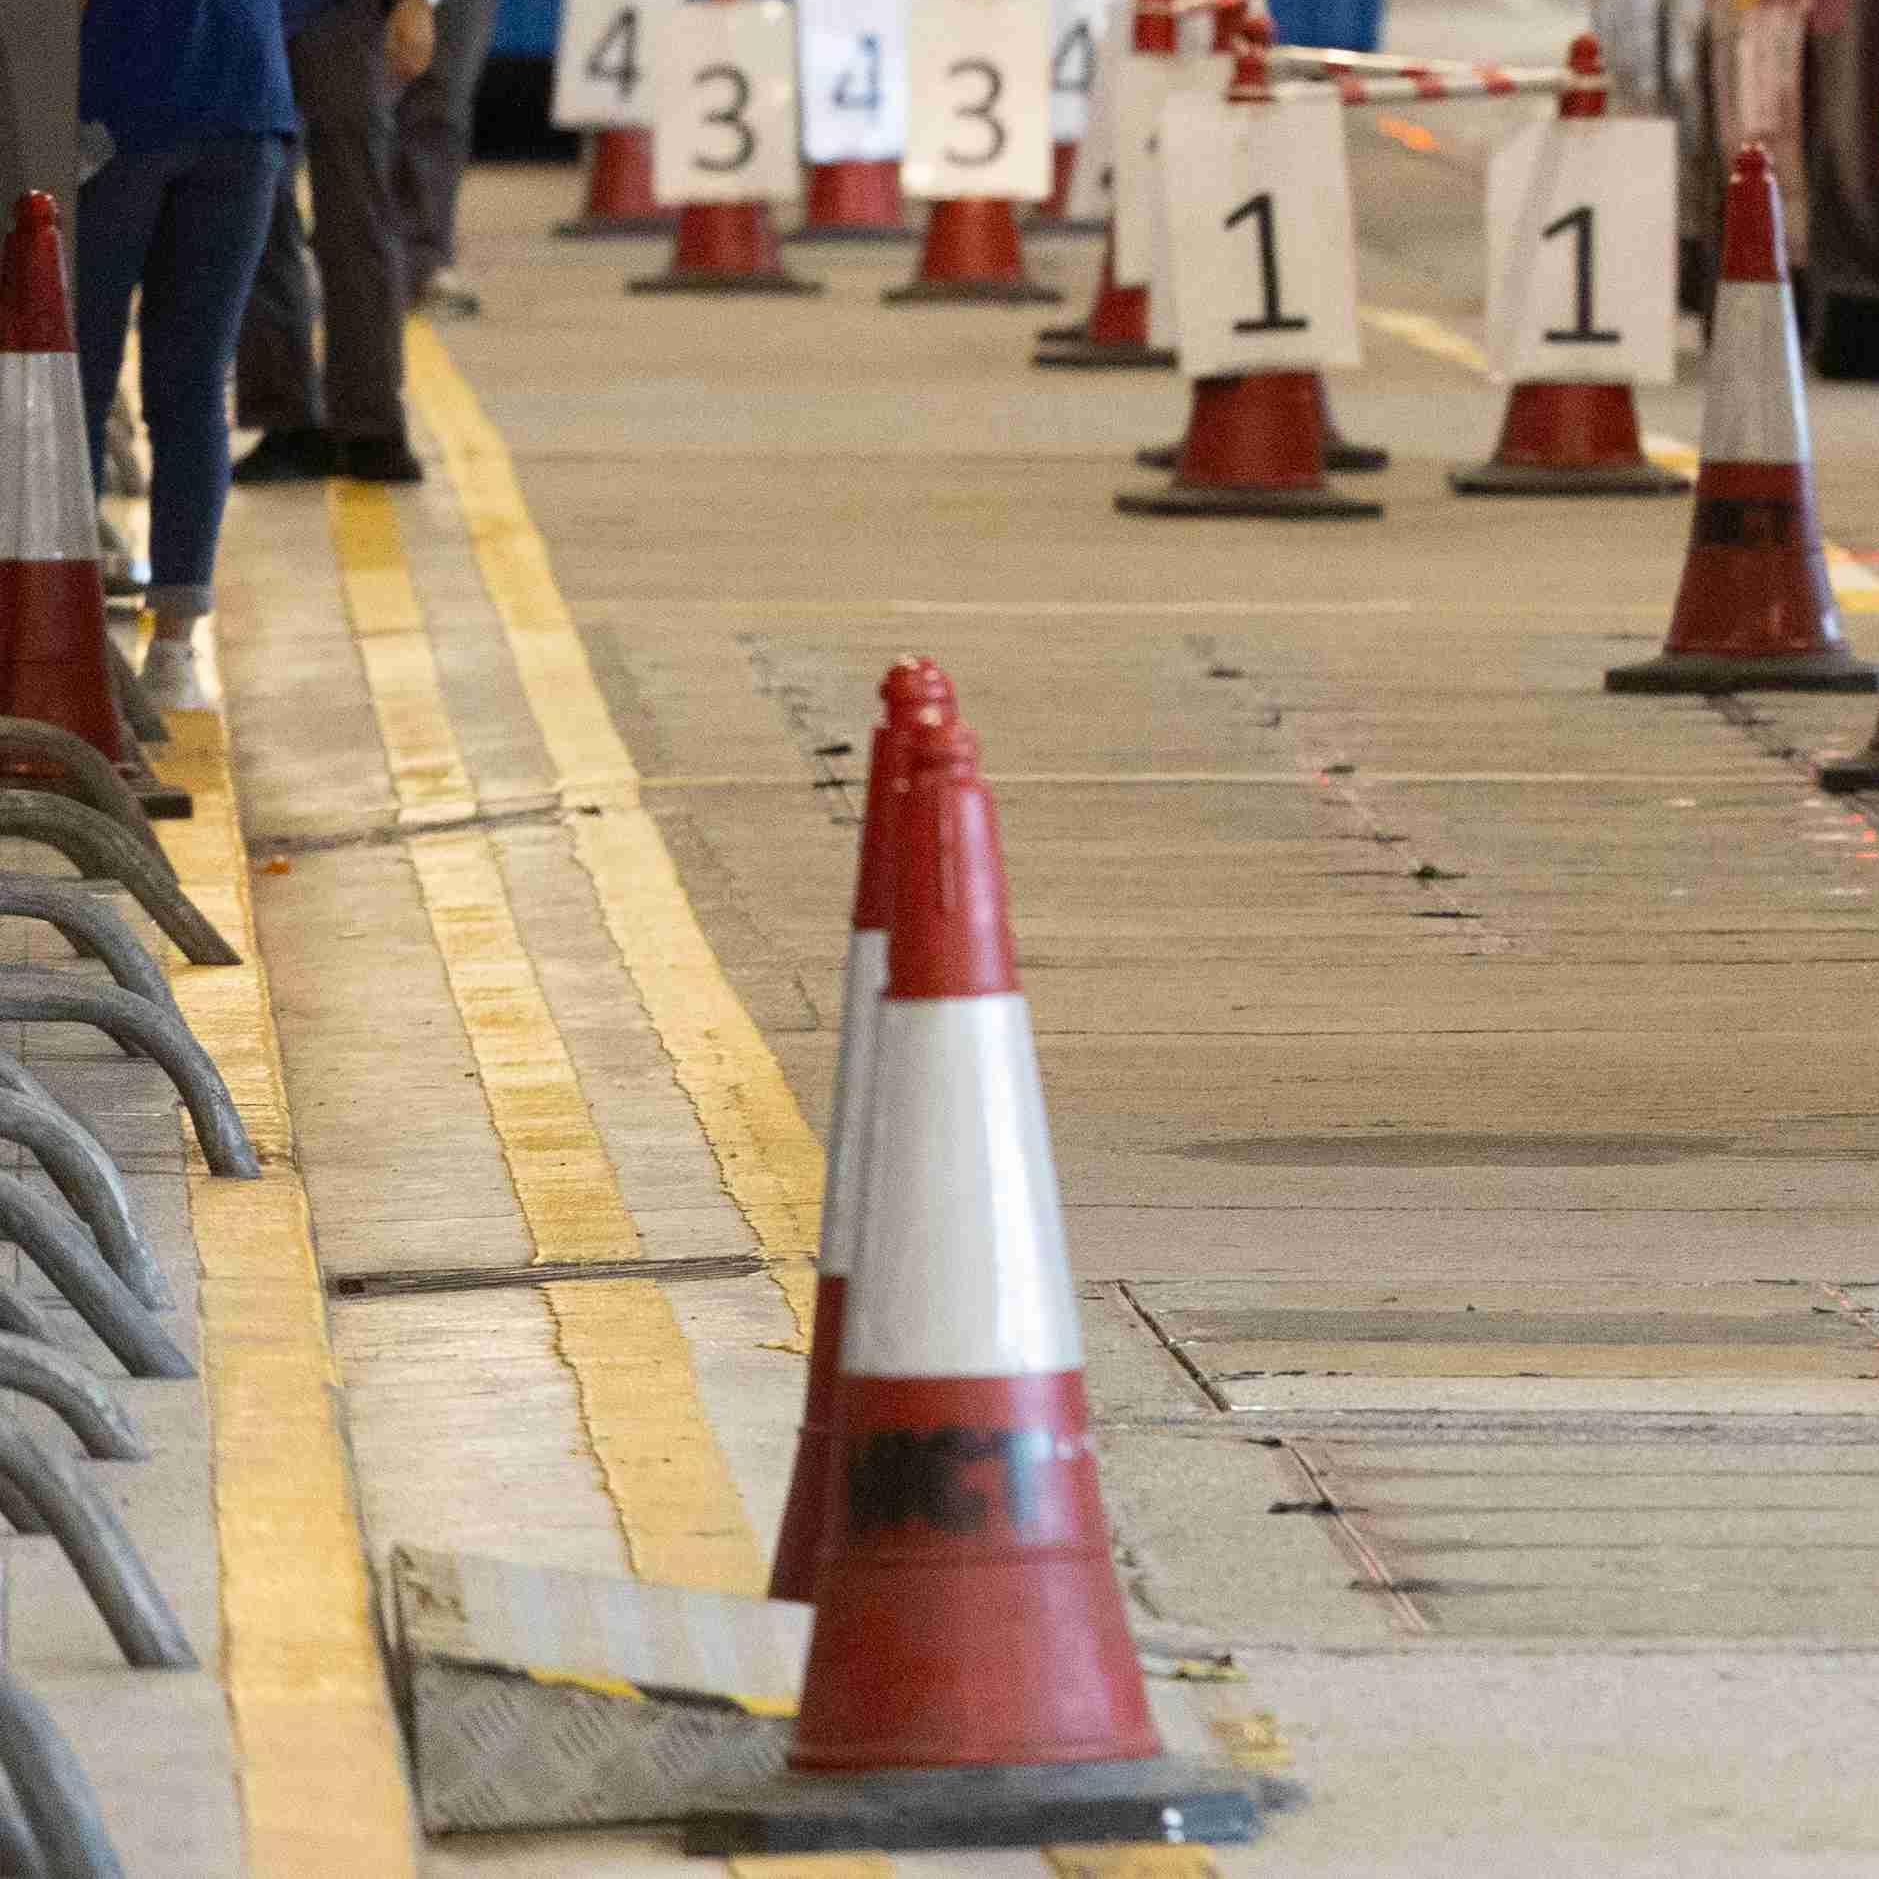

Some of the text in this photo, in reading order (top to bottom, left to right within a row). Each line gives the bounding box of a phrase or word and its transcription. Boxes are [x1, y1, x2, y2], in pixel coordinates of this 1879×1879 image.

[585, 5, 640, 99] 4
[696, 62, 756, 173] 3
[945, 59, 1007, 167] 3
[1224, 192, 1310, 334] 1
[1541, 205, 1621, 344] 1
